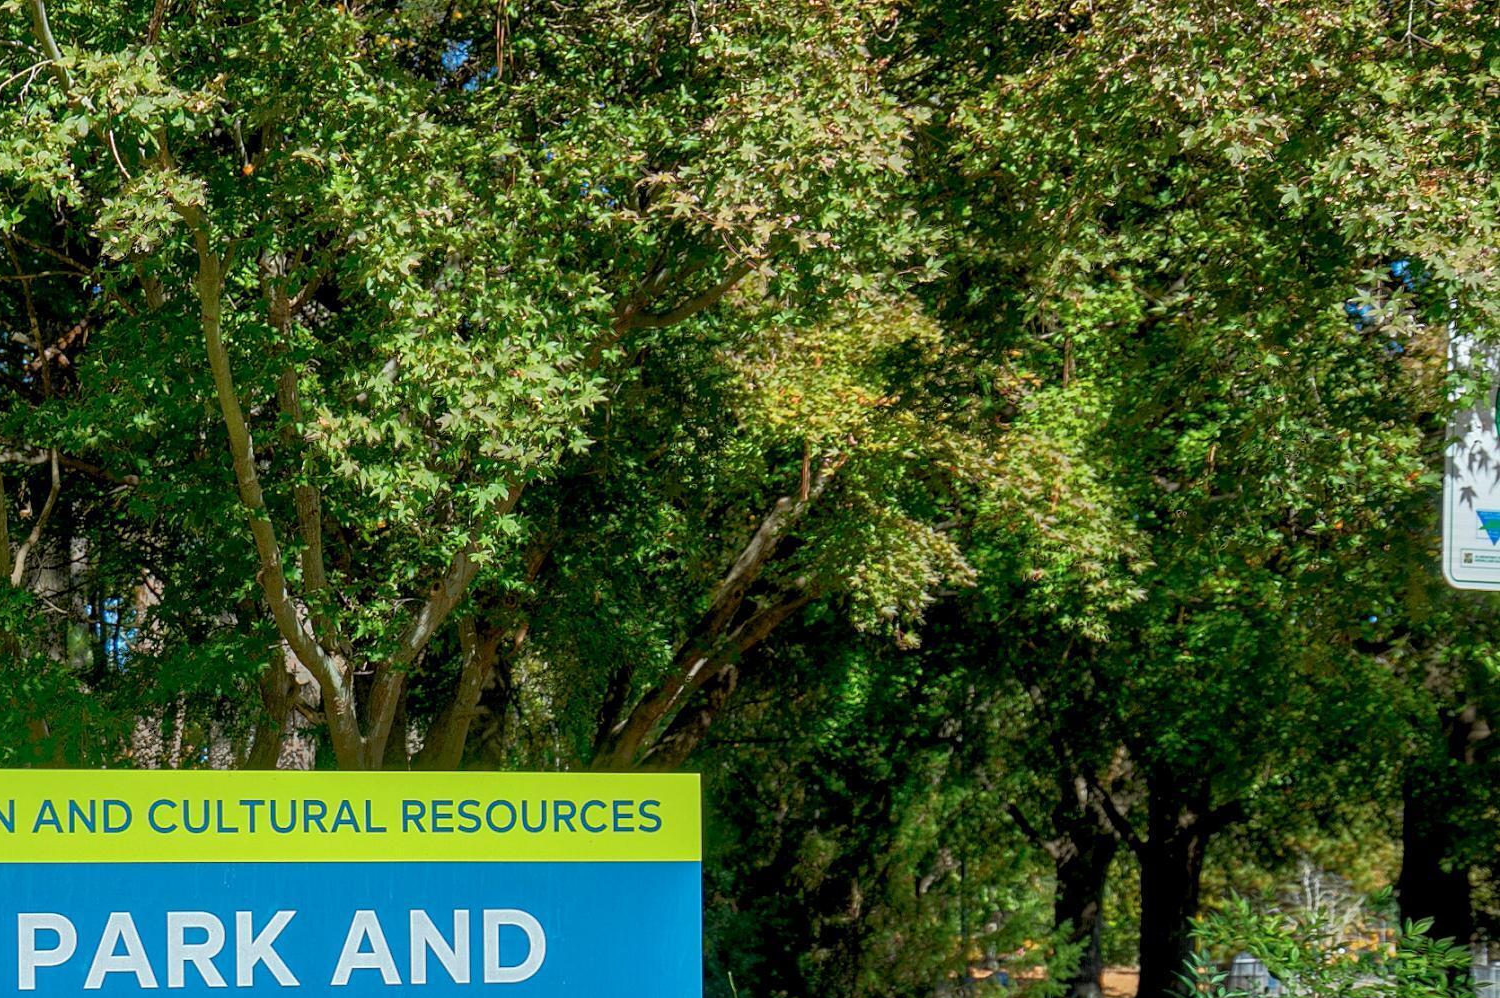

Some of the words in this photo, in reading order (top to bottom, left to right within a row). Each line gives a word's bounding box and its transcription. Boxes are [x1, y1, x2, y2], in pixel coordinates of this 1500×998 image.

[32, 799, 134, 834] AND
[148, 798, 387, 834] CULTURAL
[402, 799, 662, 834] RESOURCES
[17, 910, 300, 990] PARK
[330, 908, 547, 986] AND
